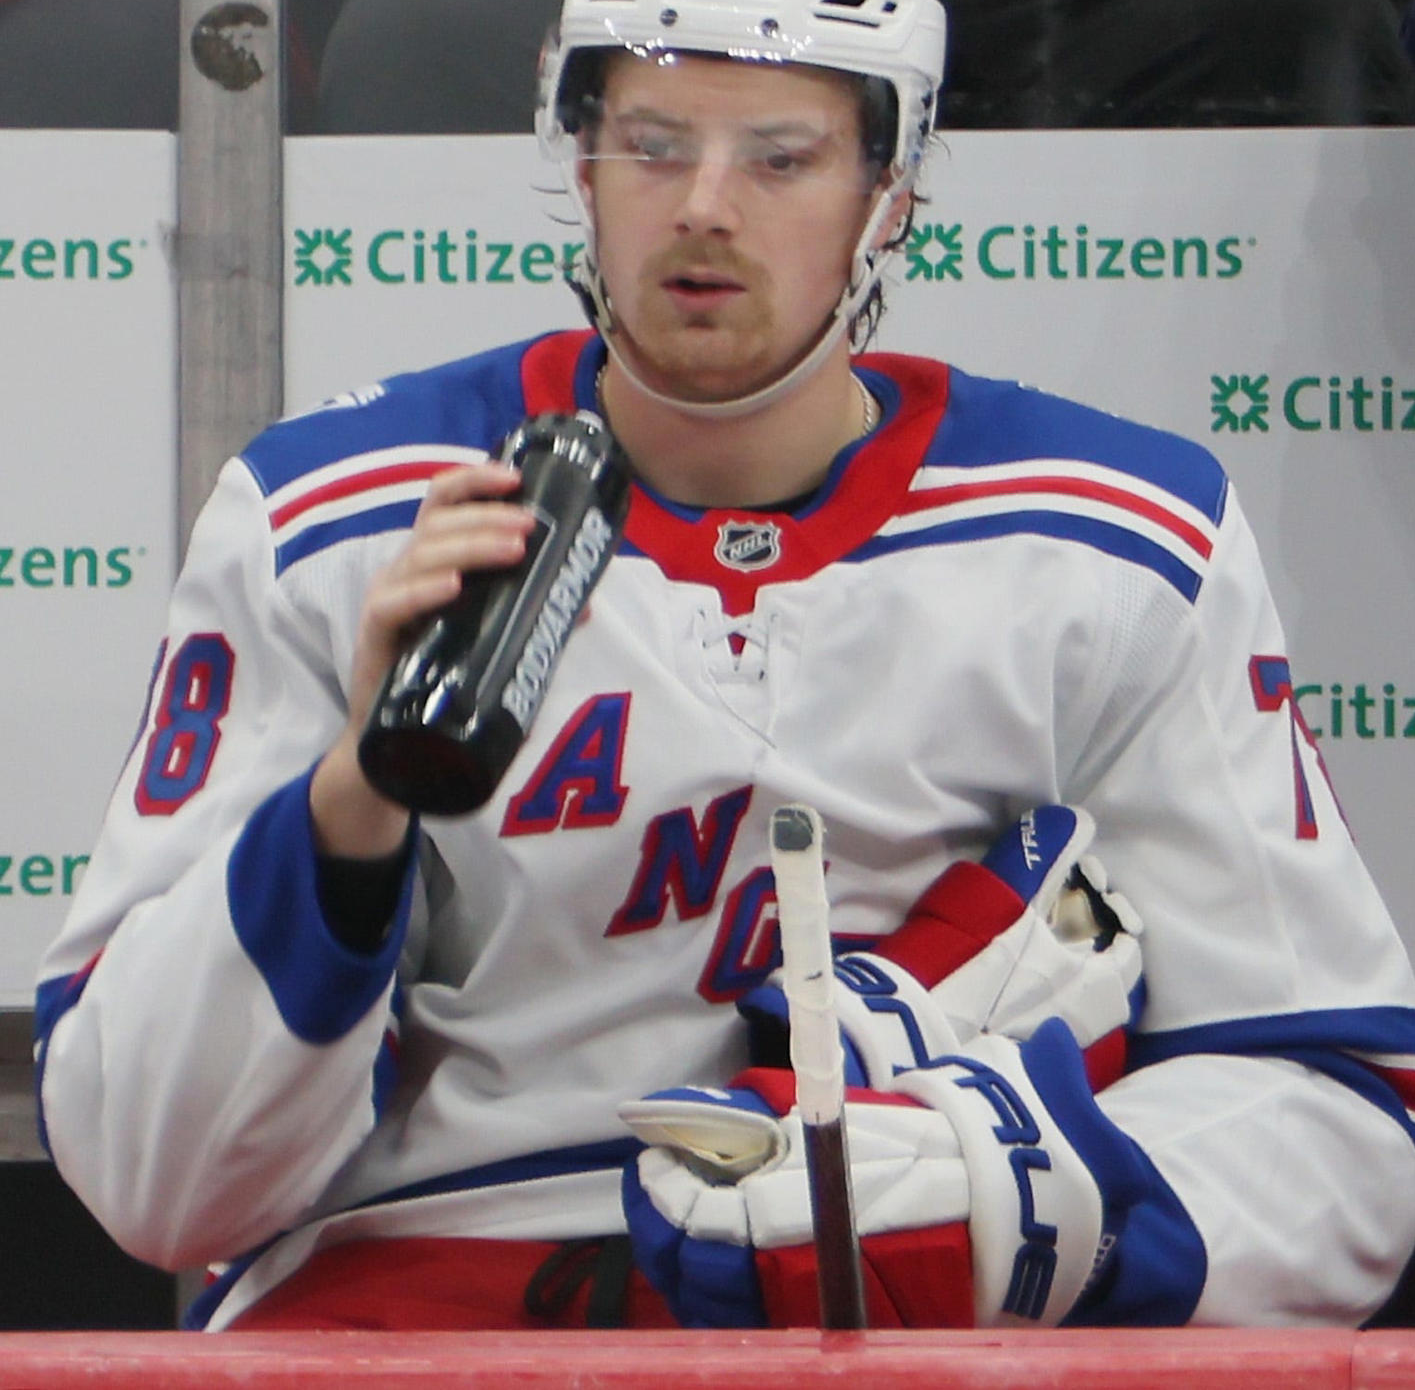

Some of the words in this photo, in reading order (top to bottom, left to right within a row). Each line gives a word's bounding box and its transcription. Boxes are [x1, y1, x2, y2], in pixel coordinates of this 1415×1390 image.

[0, 239, 133, 279] zens
[368, 230, 585, 283] Citize
[978, 225, 1243, 279] Citizens
[0, 548, 132, 587] zens
[502, 506, 613, 725] BODYARMOR
[125, 632, 236, 816] 8
[1020, 809, 1042, 871] TRU
